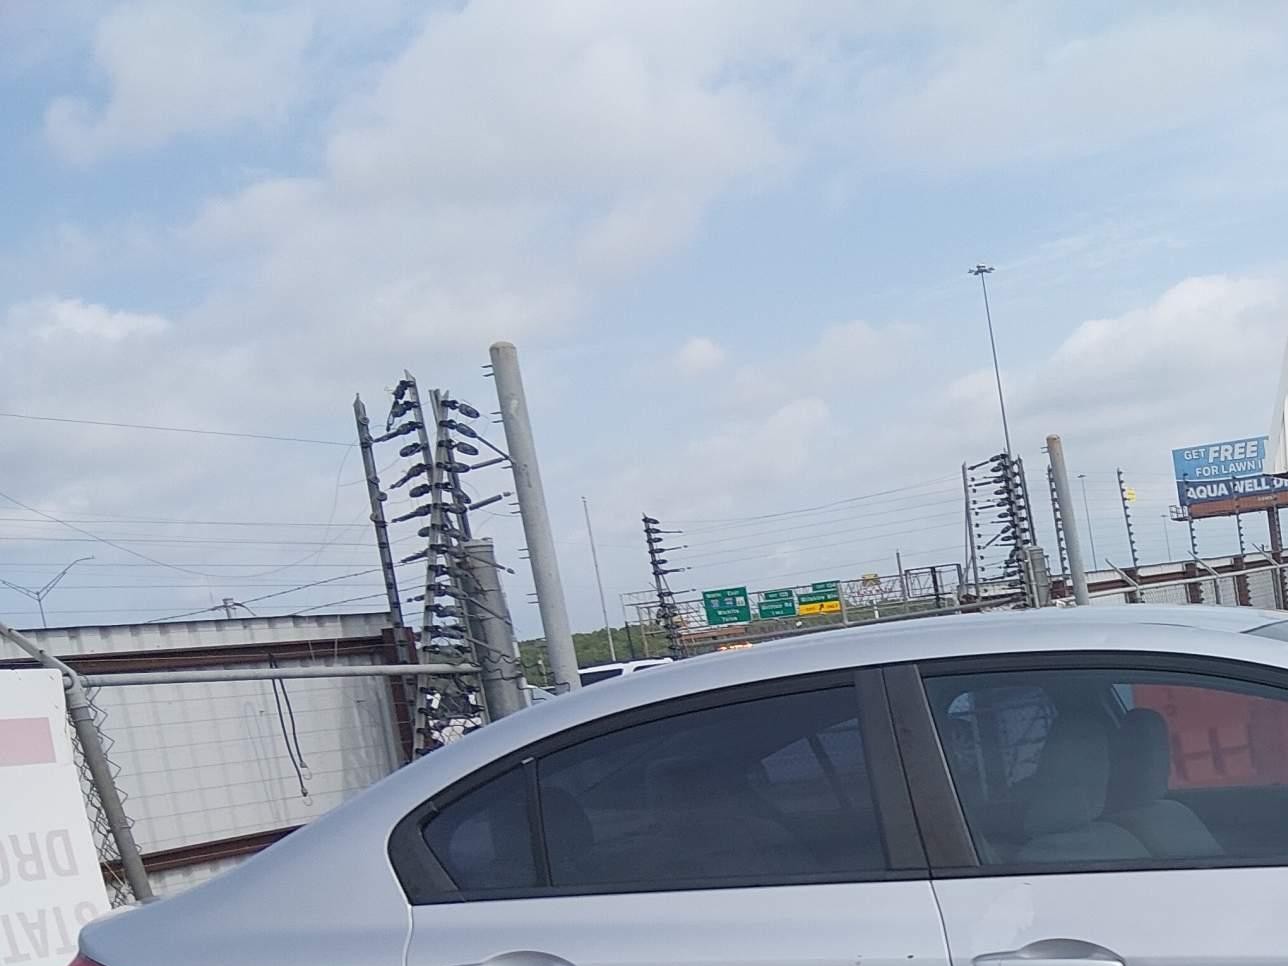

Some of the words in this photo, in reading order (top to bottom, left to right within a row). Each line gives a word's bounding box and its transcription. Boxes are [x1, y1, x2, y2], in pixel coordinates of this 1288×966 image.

[1184, 448, 1206, 461] GET
[1208, 440, 1258, 463] FREE
[1195, 465, 1221, 478] FOR
[1222, 459, 1256, 474] LAWN
[1187, 484, 1229, 500] AQUA
[1230, 477, 1271, 494] WELL
